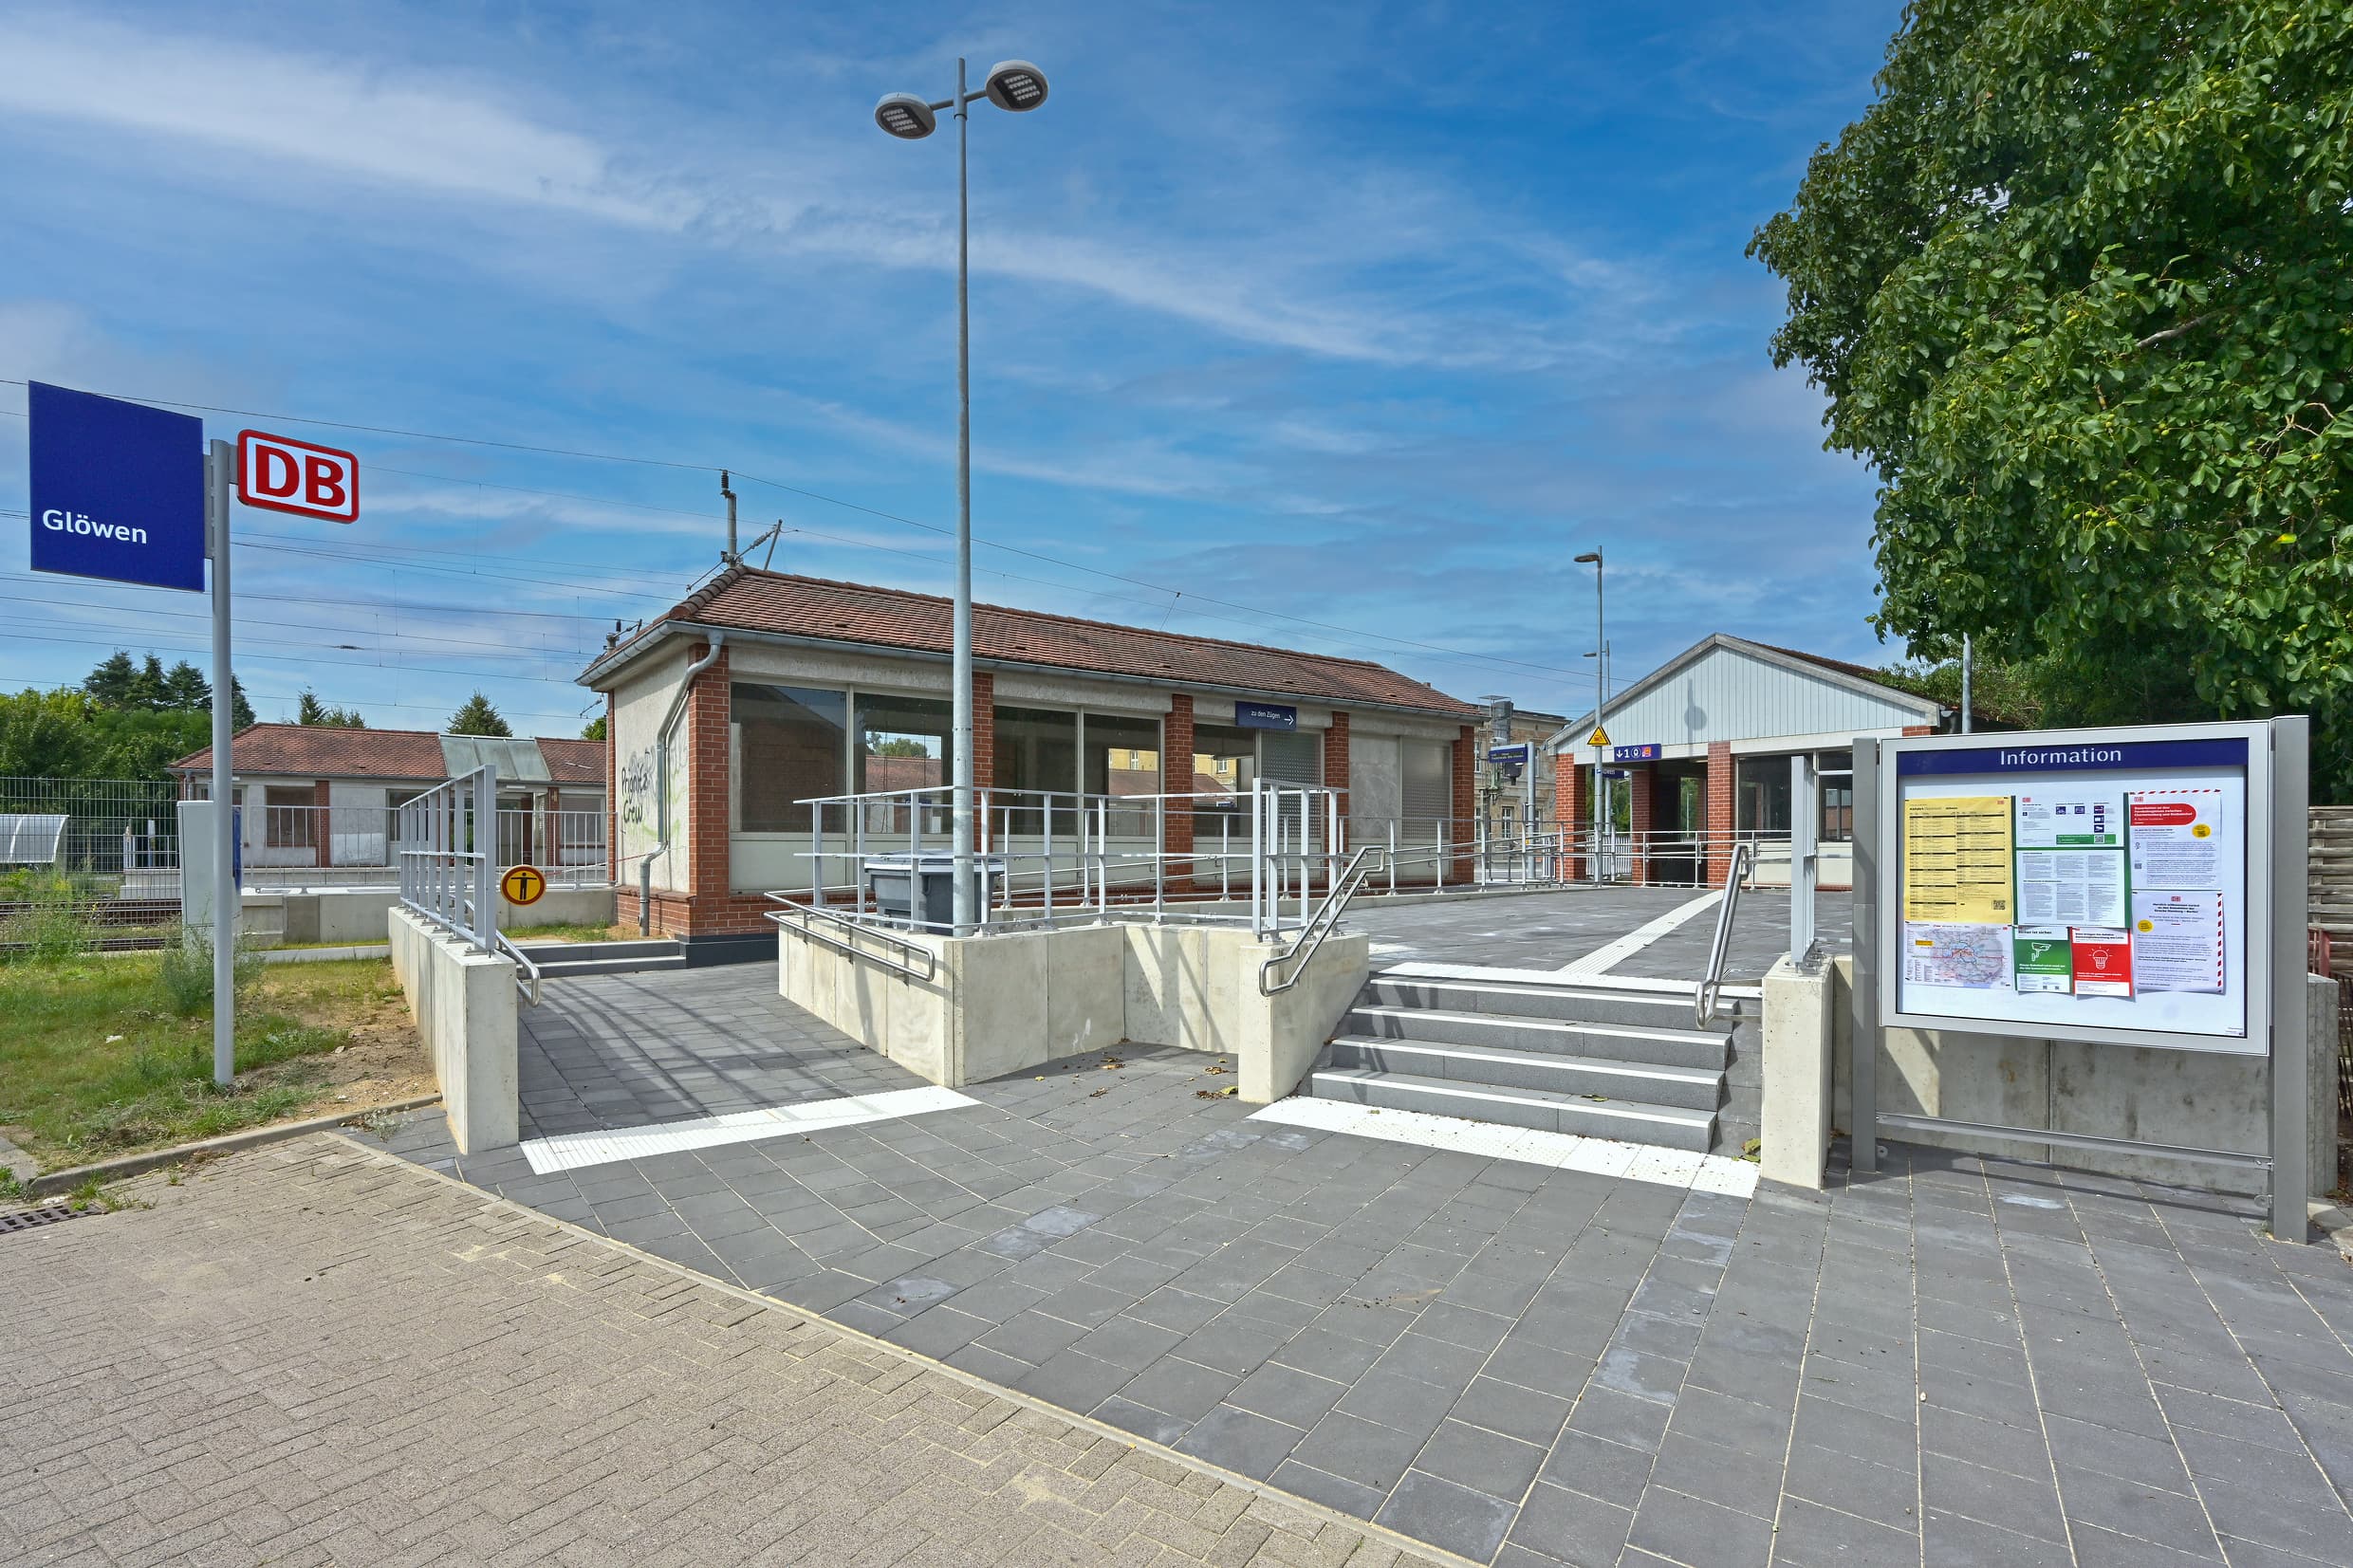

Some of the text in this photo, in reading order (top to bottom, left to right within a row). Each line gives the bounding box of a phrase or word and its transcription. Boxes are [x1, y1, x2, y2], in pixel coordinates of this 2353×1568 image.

[254, 443, 346, 507] DB
[42, 508, 147, 544] Glöwen
[1624, 748, 1630, 758] 1
[2000, 747, 2122, 766] Information
[623, 800, 642, 824] Crew
